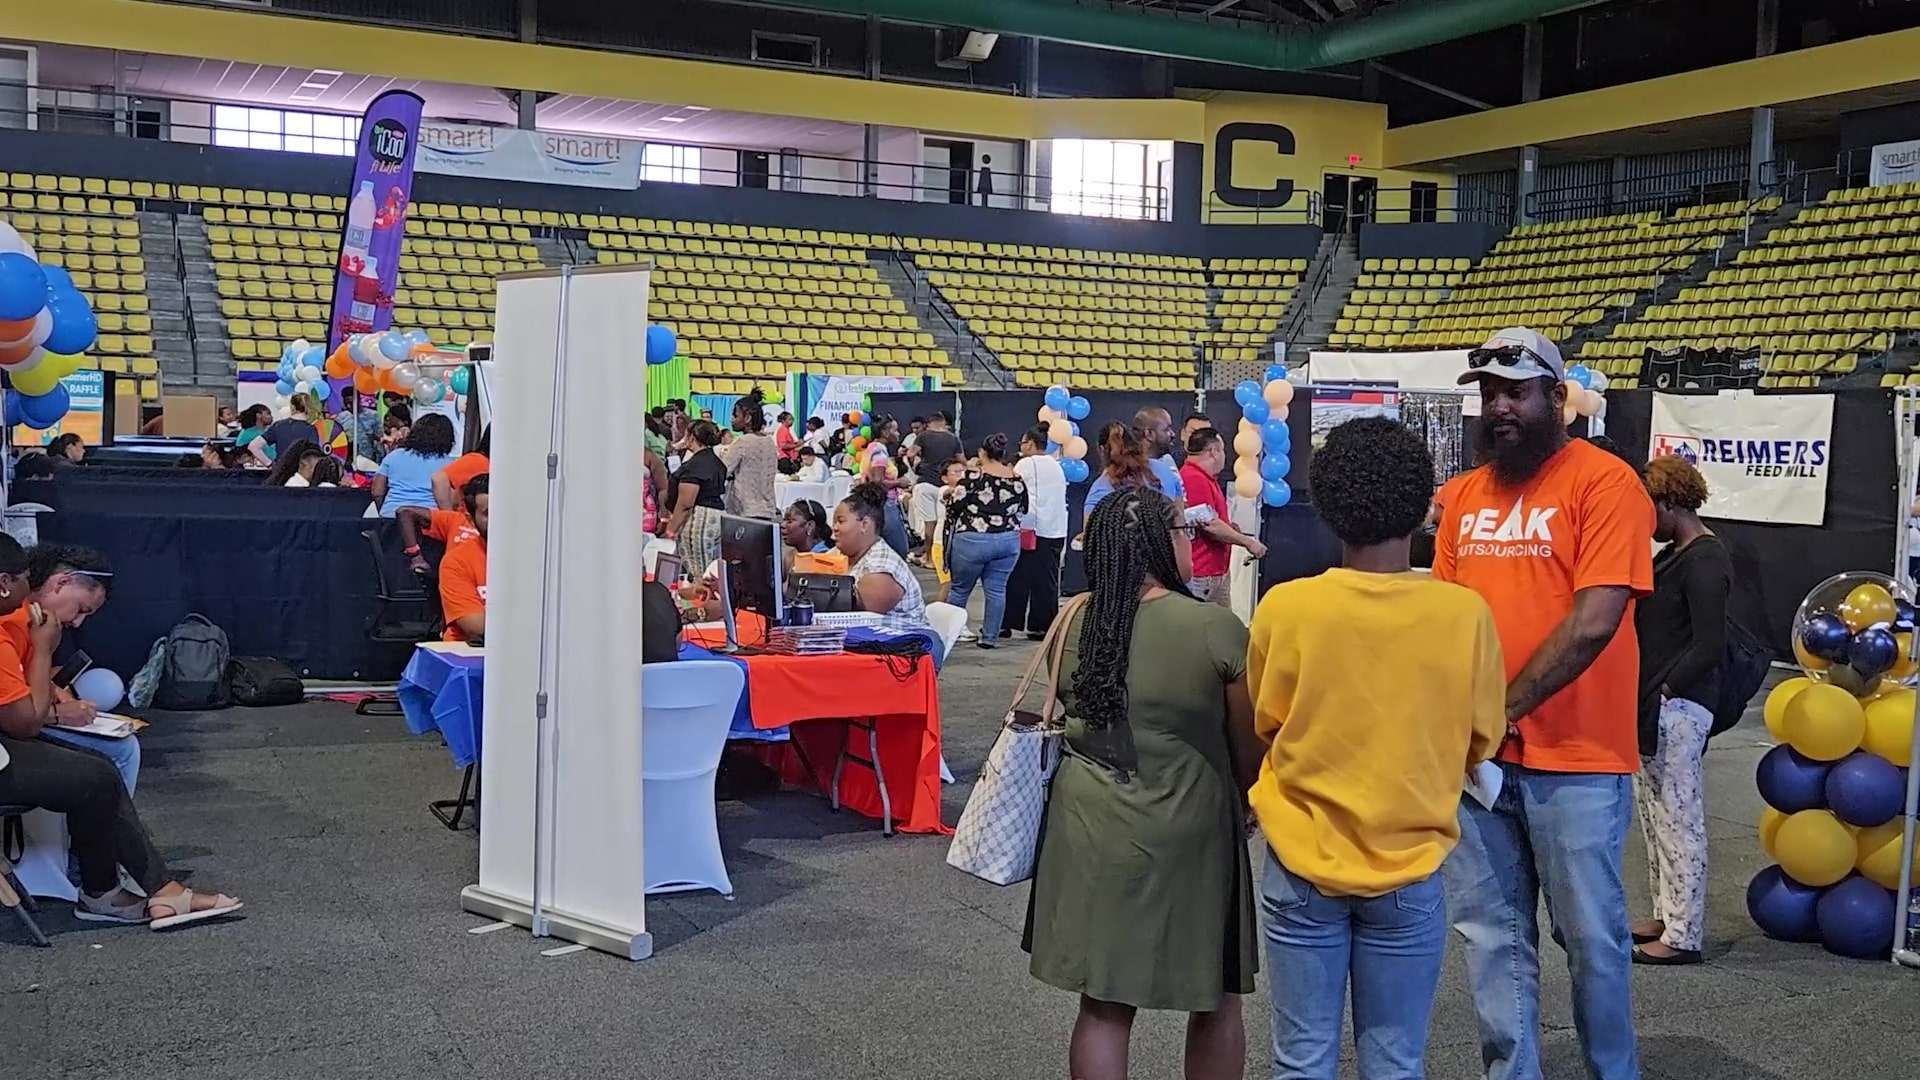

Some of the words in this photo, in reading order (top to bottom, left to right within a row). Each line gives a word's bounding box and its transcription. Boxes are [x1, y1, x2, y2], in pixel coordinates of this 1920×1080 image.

[376, 128, 407, 159] iCool
[416, 126, 494, 149] smart!
[545, 136, 620, 160] smart!
[1214, 122, 1295, 208] C
[70, 384, 101, 394] RAFFLE
[1701, 438, 1826, 466] REIMERS
[1746, 465, 1782, 478] FEED
[1783, 466, 1817, 478] MILL
[1458, 494, 1559, 544] PEAK
